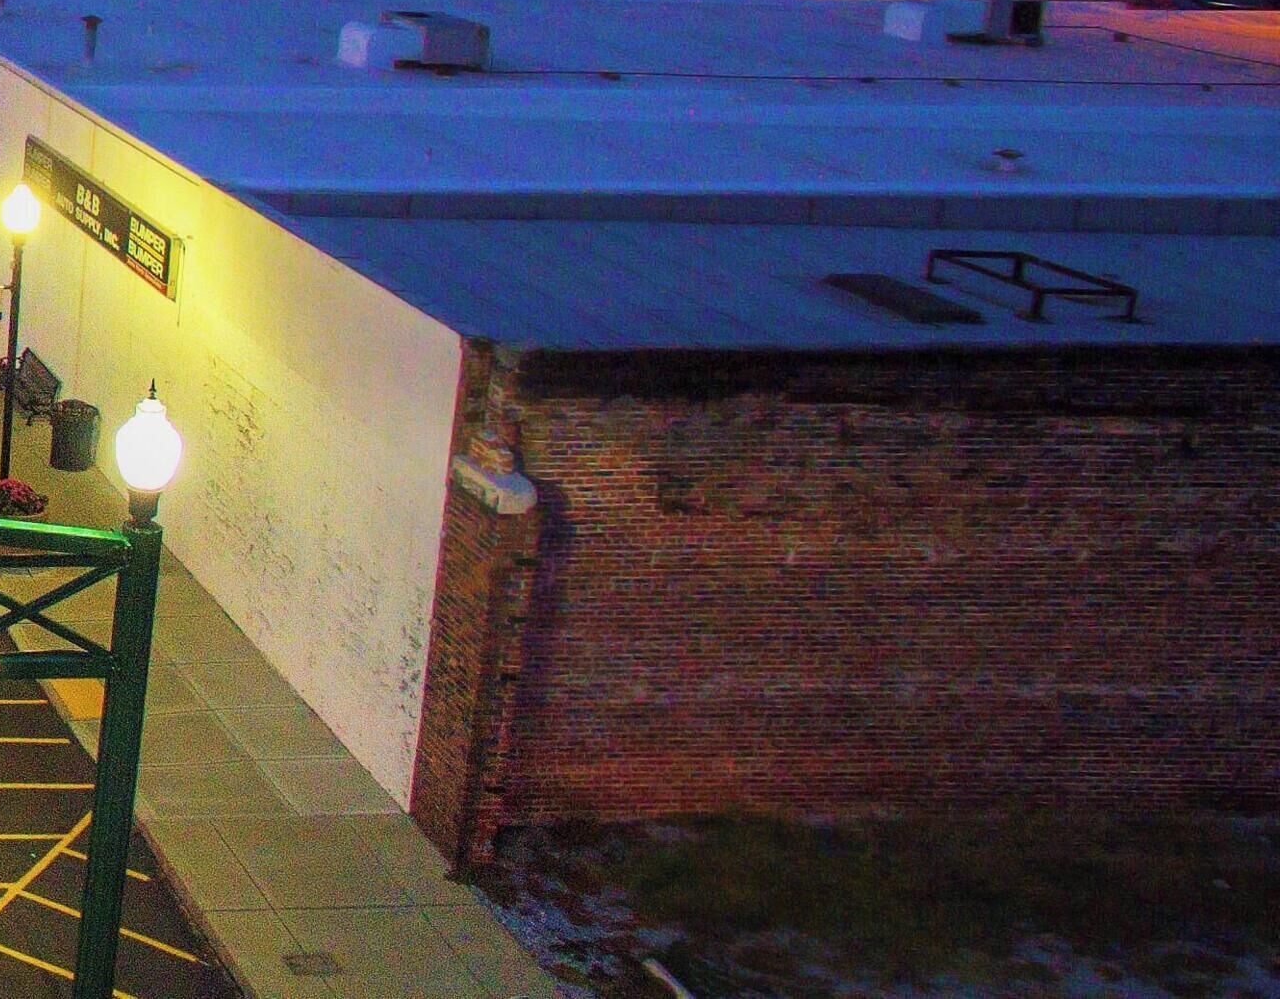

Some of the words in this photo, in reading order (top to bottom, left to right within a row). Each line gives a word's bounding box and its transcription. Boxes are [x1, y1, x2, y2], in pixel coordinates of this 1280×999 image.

[76, 183, 101, 217] B&B
[130, 216, 167, 256] BUMPER
[128, 239, 164, 279] BUMPER
